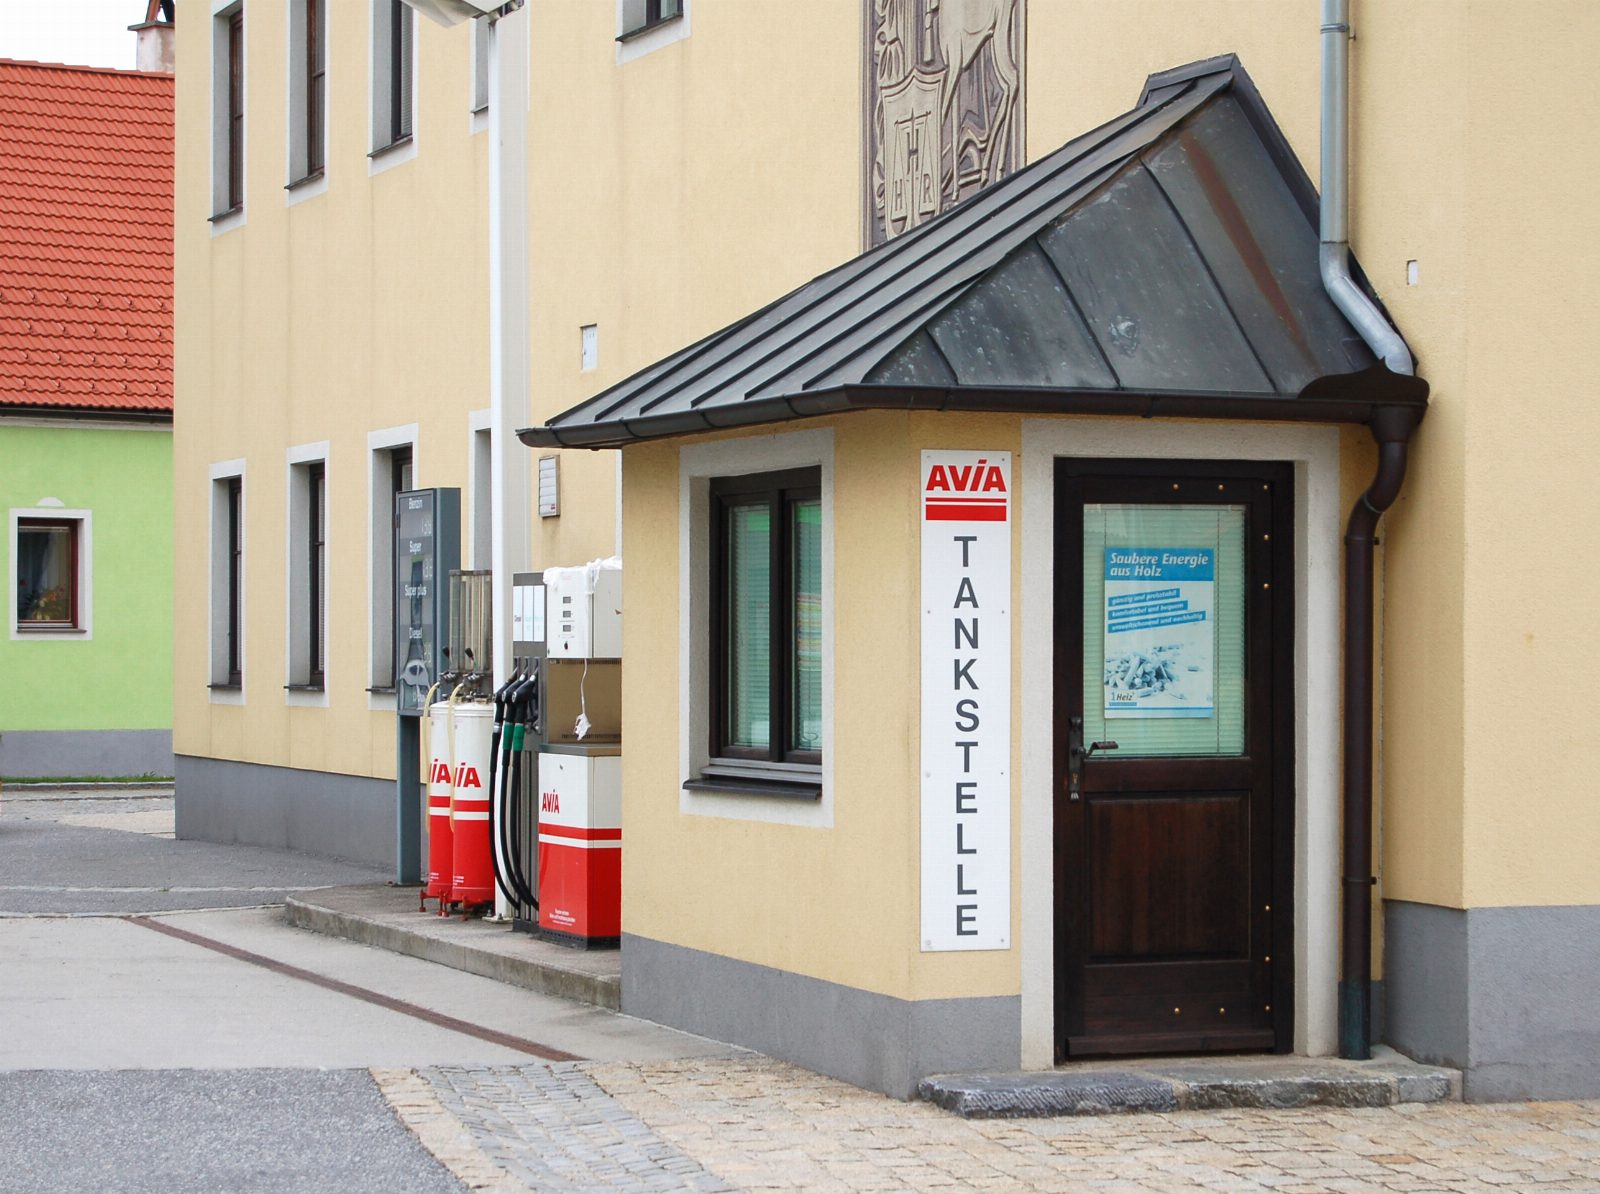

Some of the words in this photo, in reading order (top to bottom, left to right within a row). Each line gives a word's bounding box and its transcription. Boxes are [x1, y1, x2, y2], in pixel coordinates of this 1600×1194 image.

[409, 540, 422, 555] Super
[1110, 552, 1158, 565] Saubere
[1162, 553, 1209, 568] Energie
[1110, 567, 1130, 577] aus
[1134, 565, 1162, 577] Holz
[953, 536, 980, 936] TANKSTELLE
